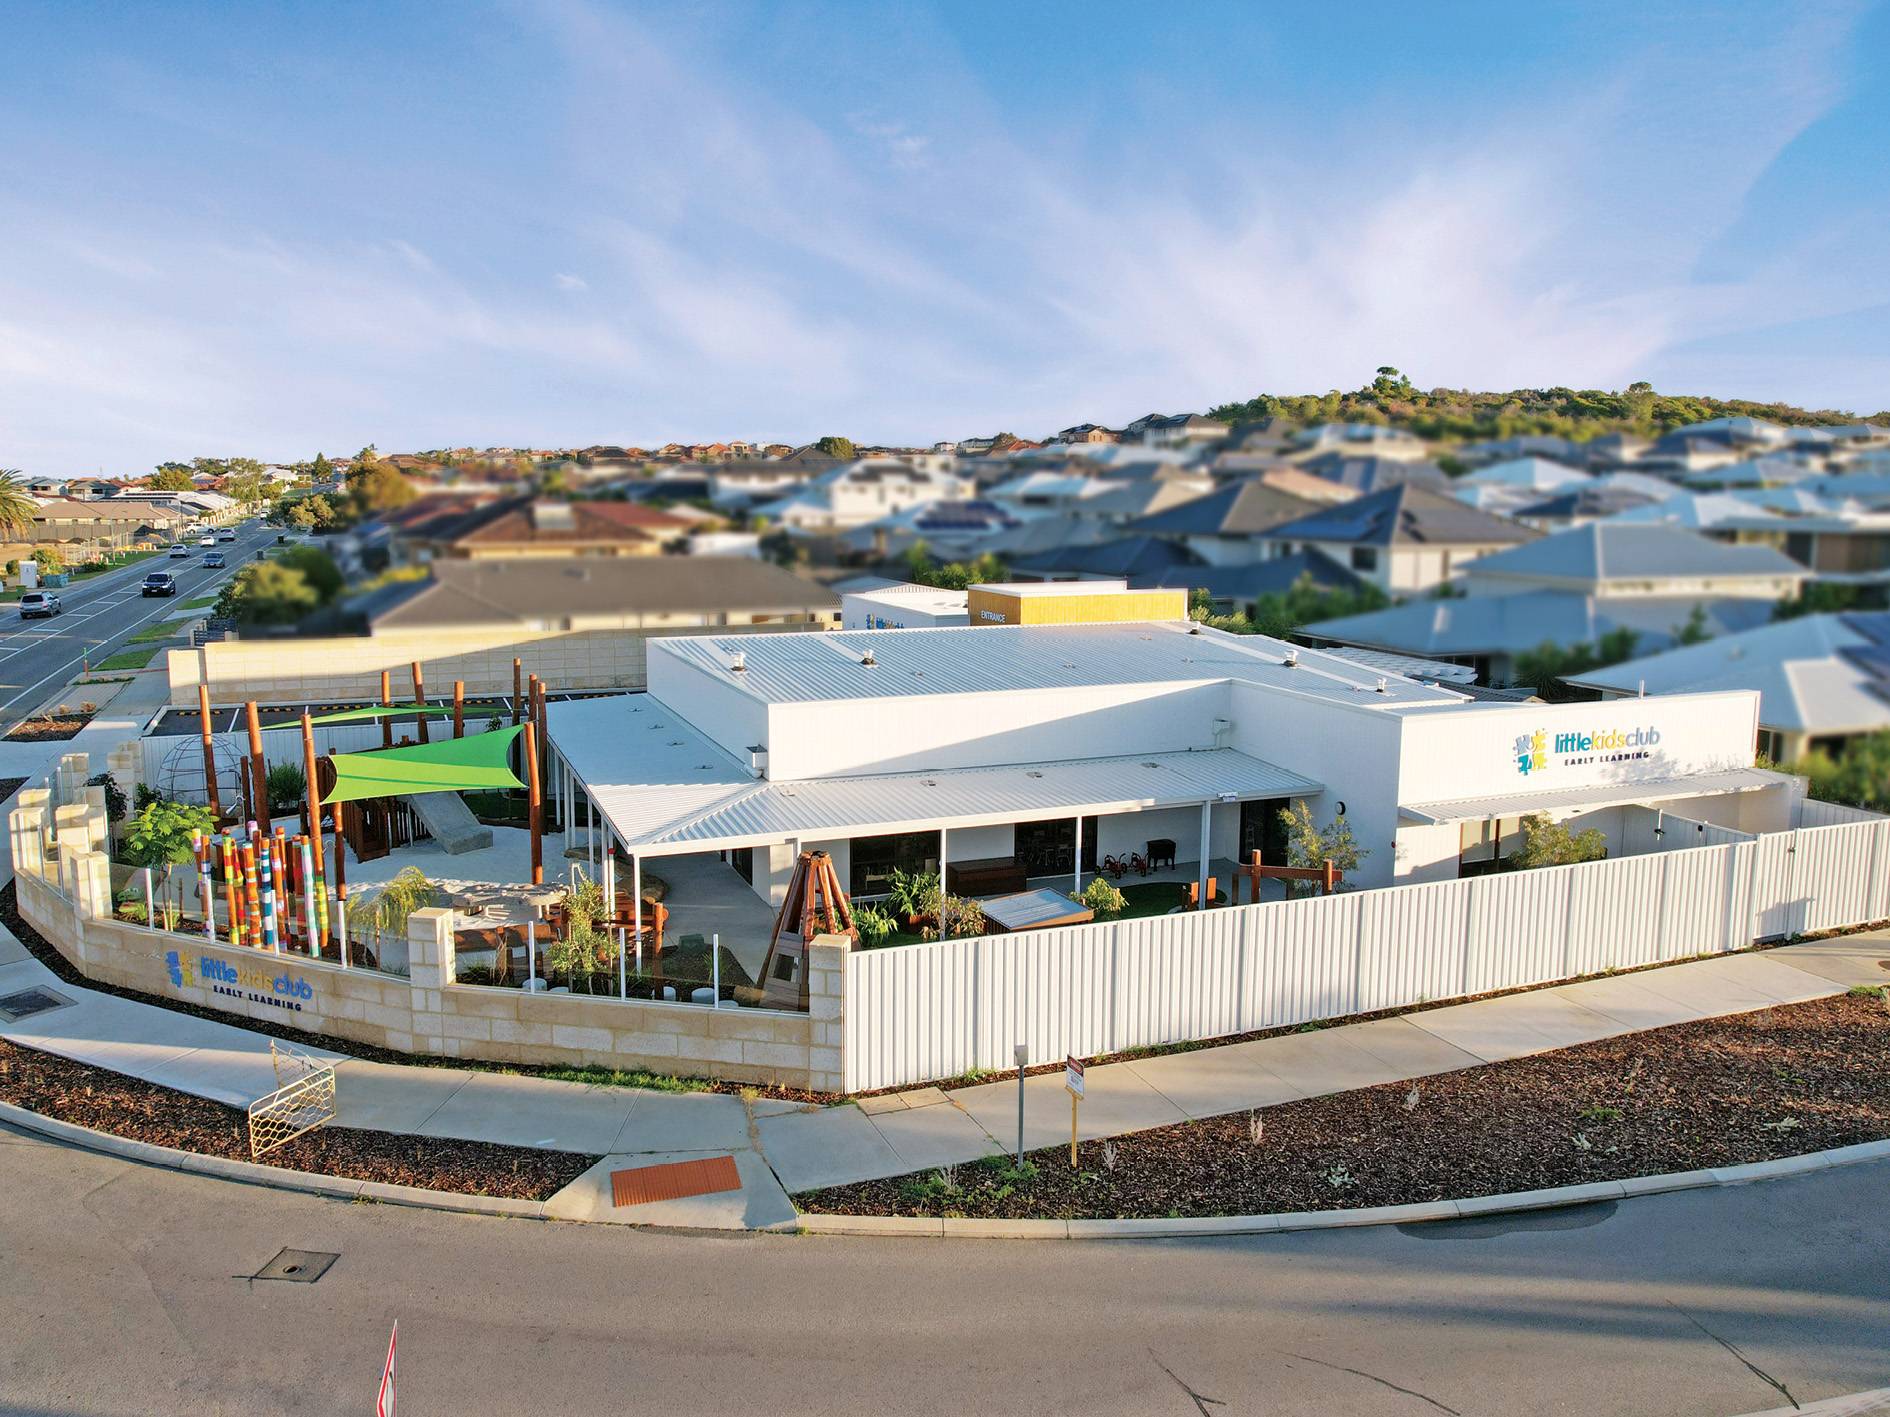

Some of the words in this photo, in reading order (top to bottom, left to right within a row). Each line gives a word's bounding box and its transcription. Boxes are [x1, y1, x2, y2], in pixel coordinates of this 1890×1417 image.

[980, 610, 1006, 623] ENTRANCE
[1554, 726, 1661, 754] littlekidsclub
[1564, 757, 1595, 766] EARLY
[1599, 751, 1650, 763] LEARNING
[200, 956, 313, 1000] littlekidsclub
[213, 985, 243, 998] EARLY
[248, 993, 302, 1012] LEARNING
